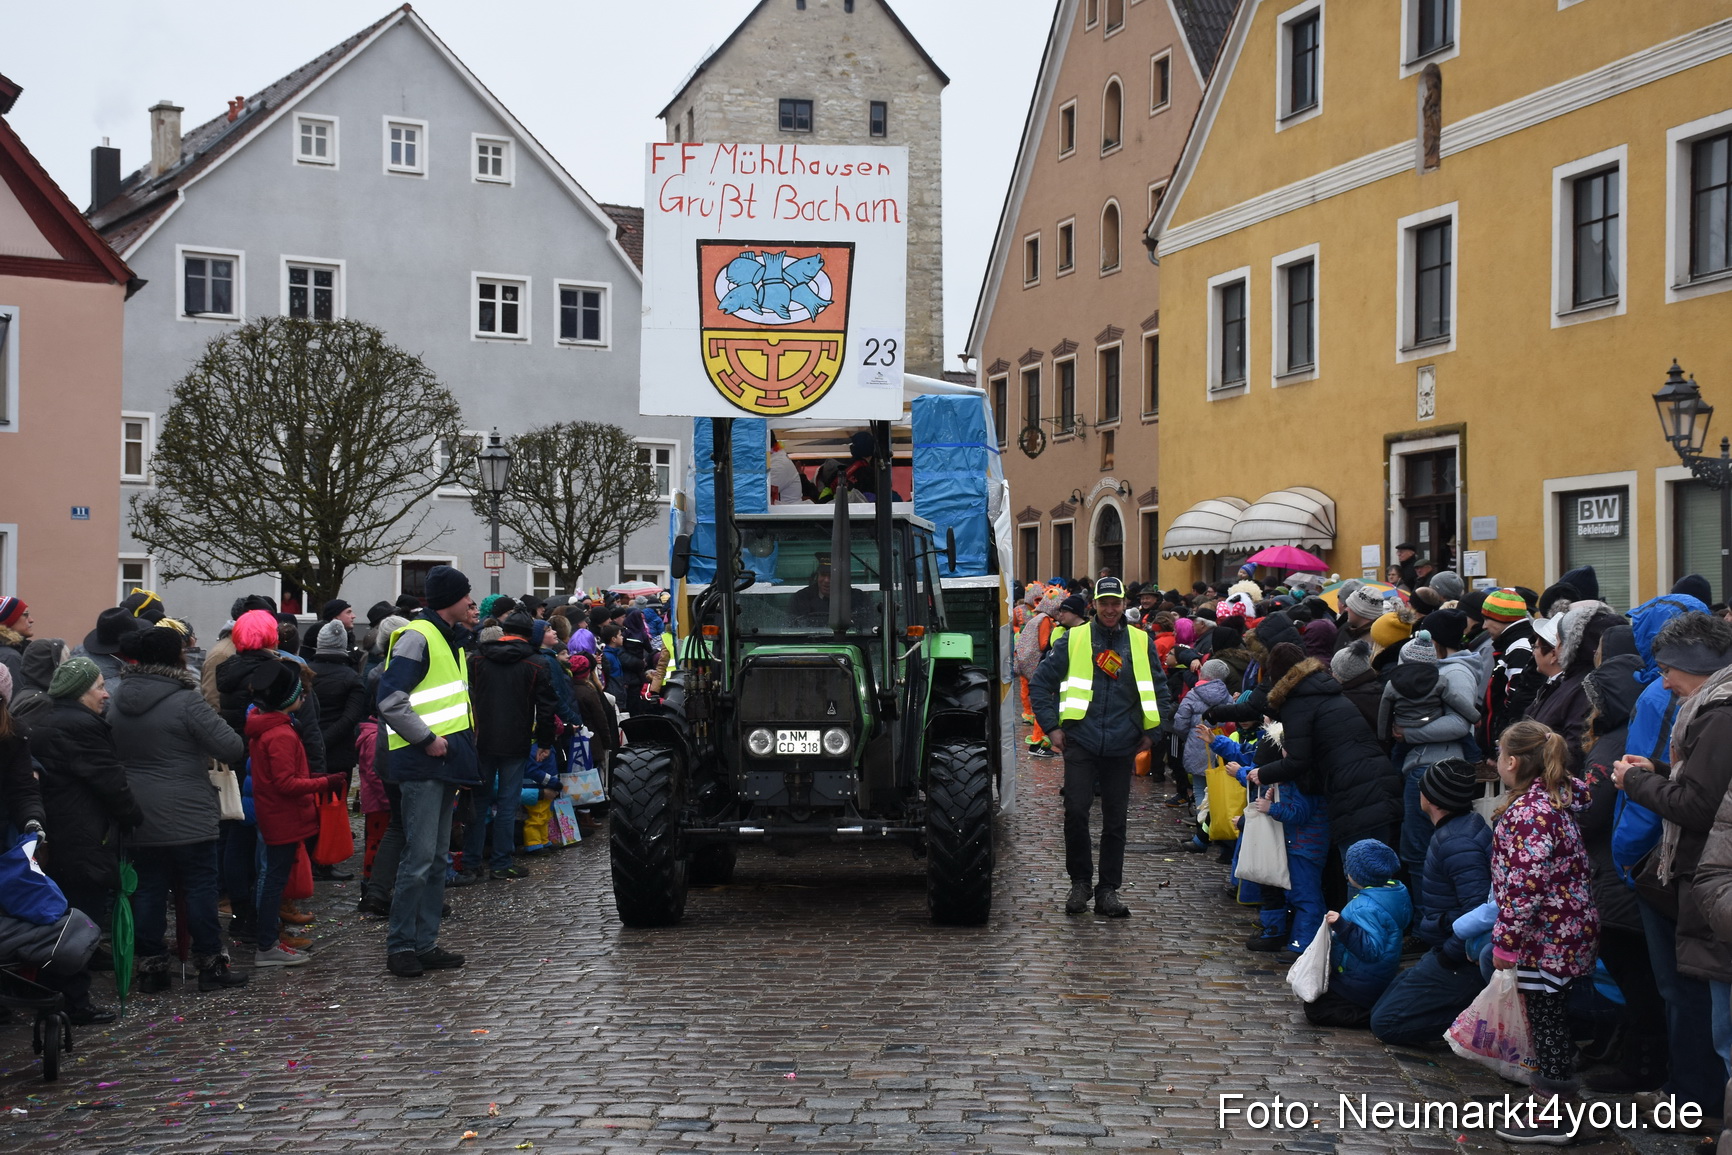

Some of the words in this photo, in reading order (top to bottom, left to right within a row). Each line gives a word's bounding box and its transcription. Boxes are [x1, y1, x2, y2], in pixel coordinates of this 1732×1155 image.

[710, 143, 890, 176] Mühlhausen
[659, 173, 757, 233] Grüßt
[773, 184, 901, 223] Bacham
[863, 337, 897, 367] 23
[77, 507, 86, 515] 11
[1579, 497, 1618, 521] BW
[1578, 523, 1619, 536] Bekleidung
[790, 731, 807, 741] NM
[779, 742, 795, 753] CD
[800, 742, 818, 753] 318
